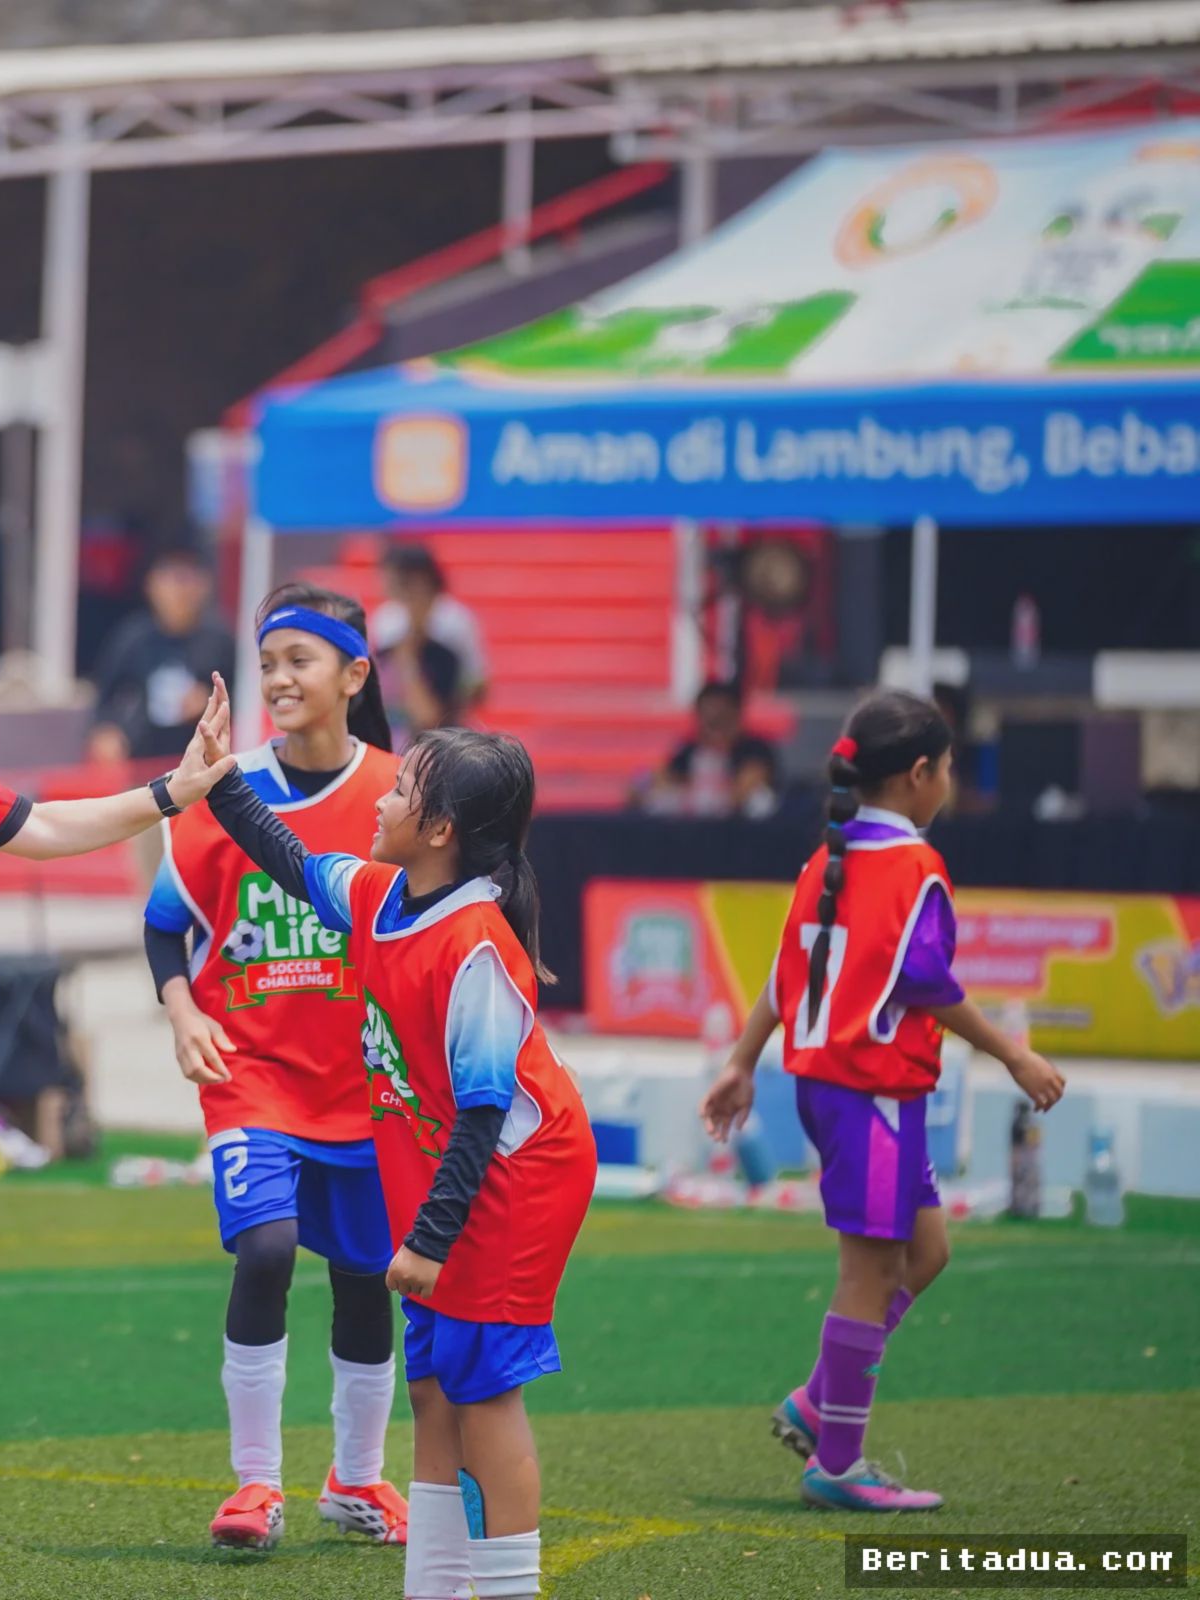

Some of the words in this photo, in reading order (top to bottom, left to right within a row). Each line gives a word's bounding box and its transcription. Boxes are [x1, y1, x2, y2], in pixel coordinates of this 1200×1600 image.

[492, 420, 660, 485] Aman
[666, 415, 726, 483] di
[1044, 410, 1200, 476] Beba
[265, 914, 342, 957] Life
[257, 973, 334, 990] CHALLENGE
[267, 960, 321, 976] SOCCER
[223, 1146, 248, 1199] 2
